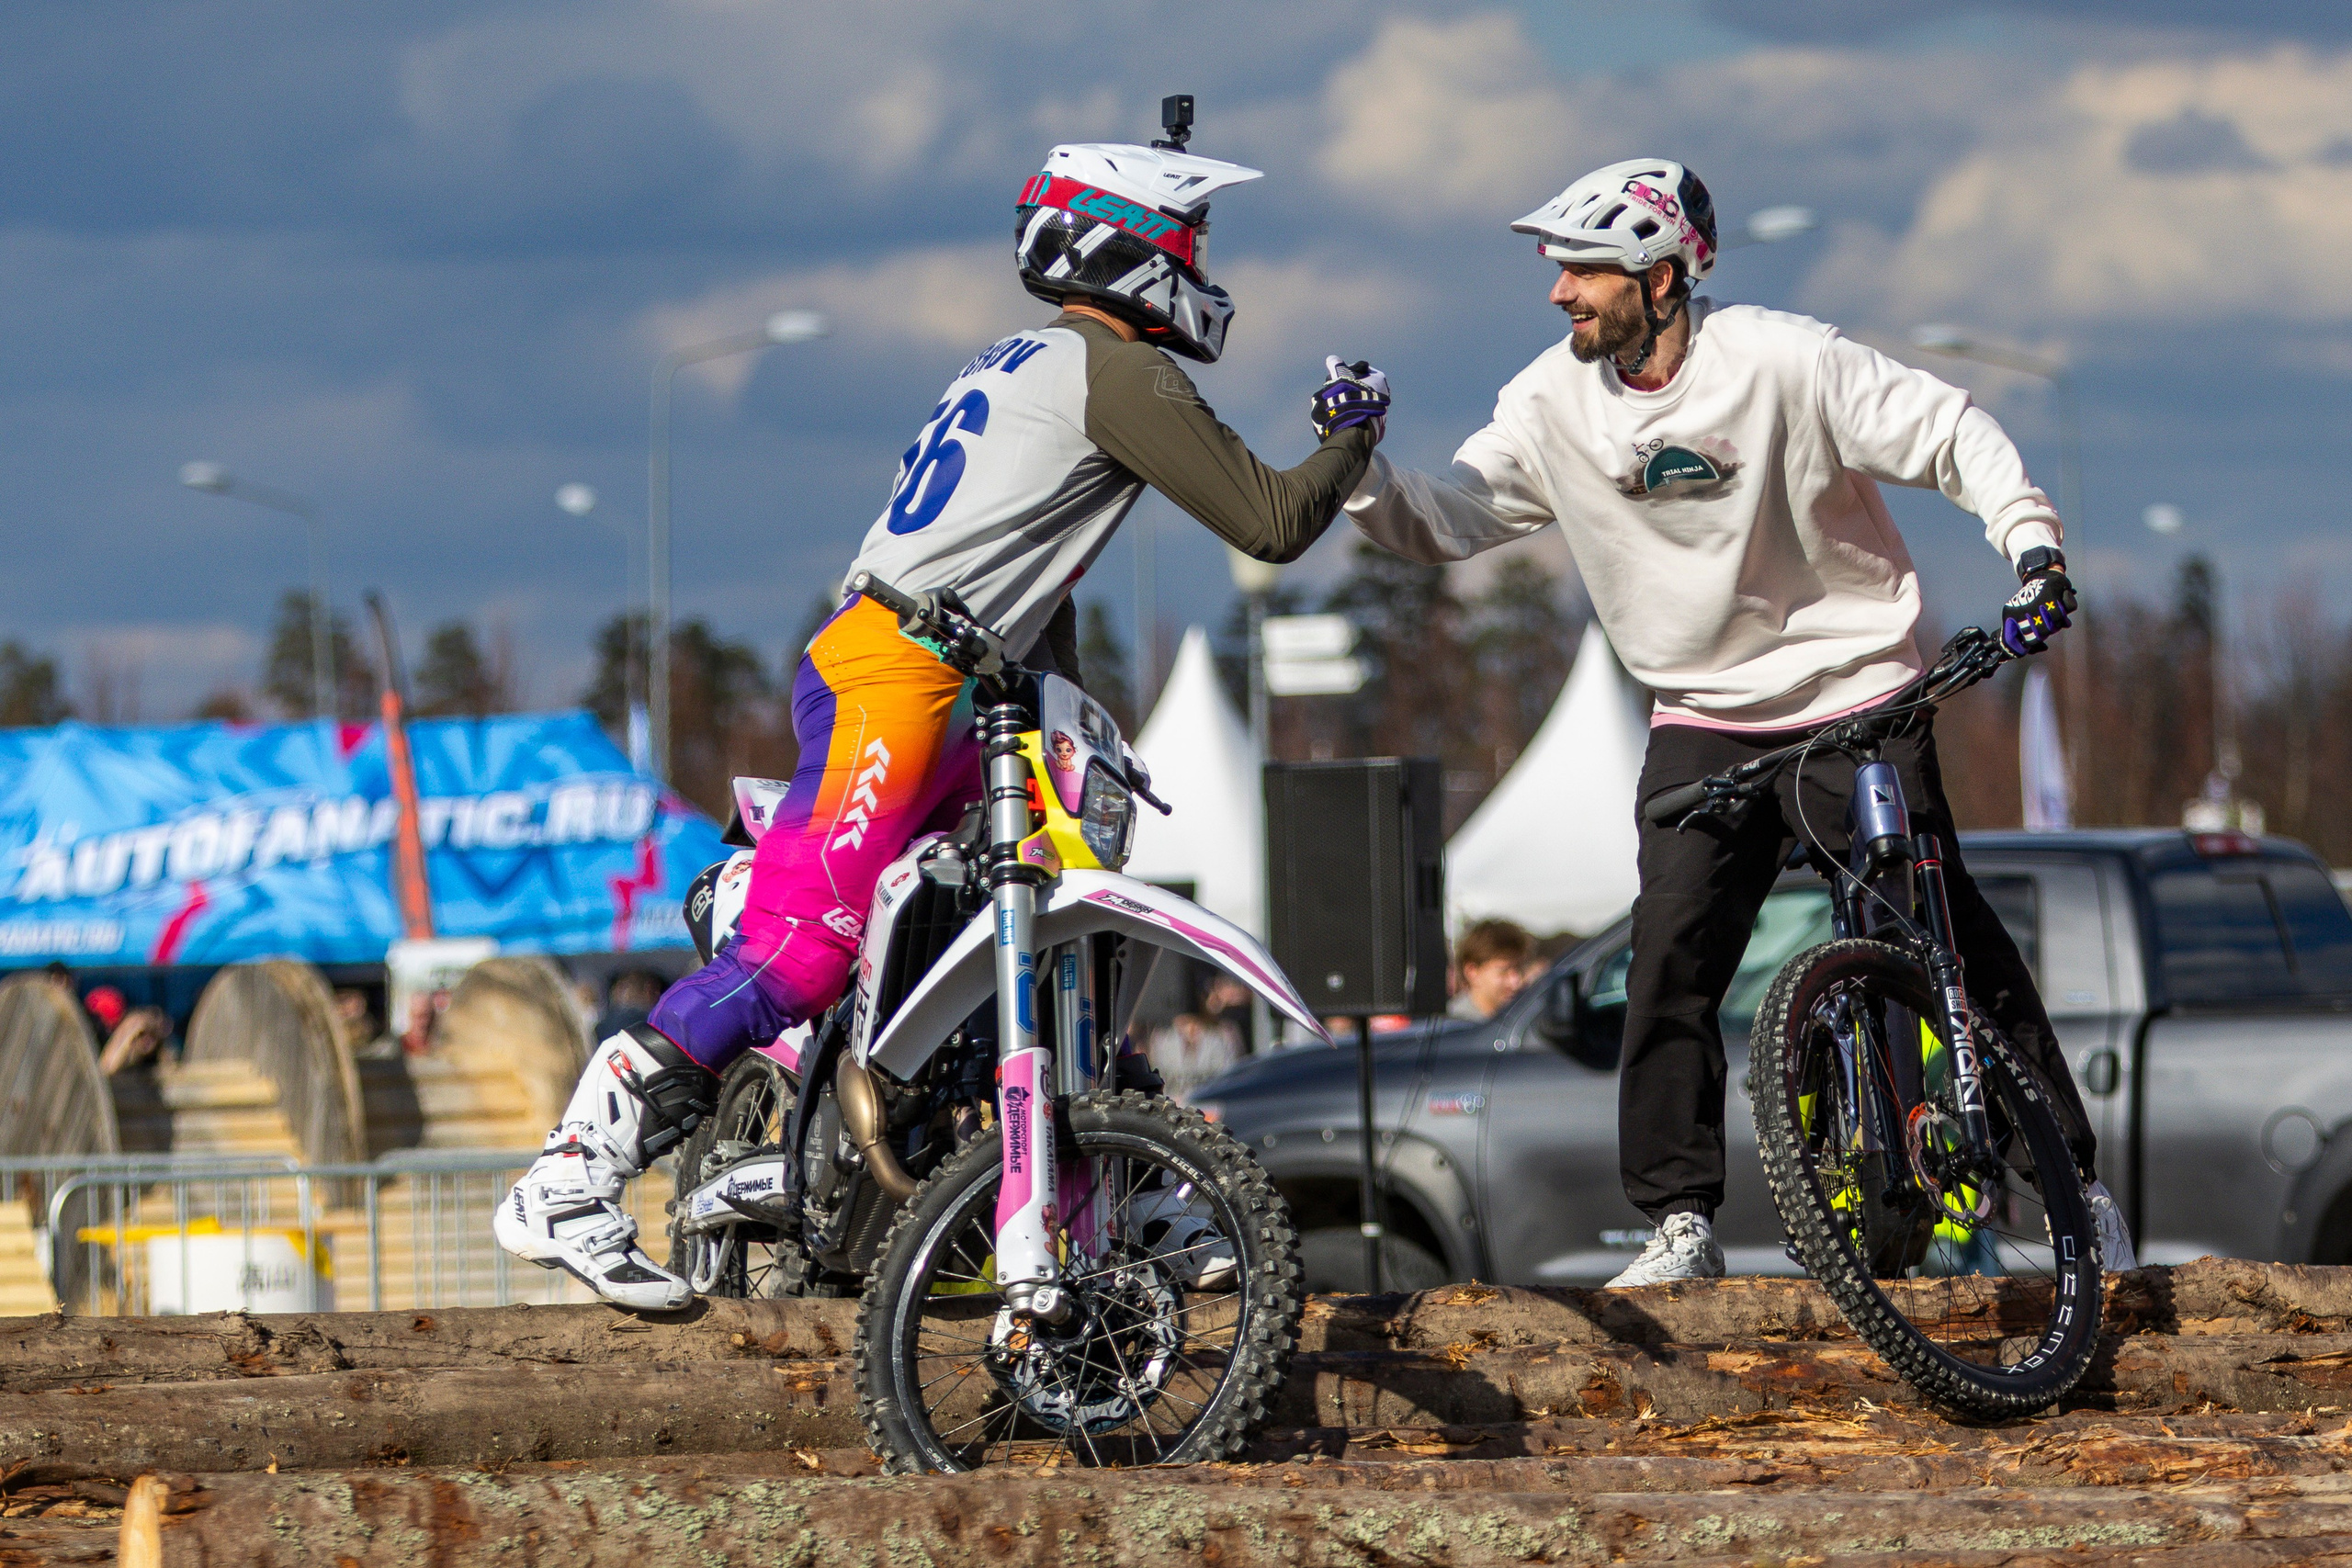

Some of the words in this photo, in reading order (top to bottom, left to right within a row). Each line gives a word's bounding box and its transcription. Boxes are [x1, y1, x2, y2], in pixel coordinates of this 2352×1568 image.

[1068, 188, 1182, 241] LEATT
[1631, 195, 1646, 208] RIDE
[1648, 204, 1662, 216] FOR
[1662, 213, 1676, 226] FUN
[1661, 468, 1681, 477] TRIAL
[1681, 465, 1703, 474] NINJA
[1968, 1009, 2039, 1101] MAXXIS
[1170, 1156, 1200, 1180] EXCEL
[513, 1186, 528, 1227] LEATT
